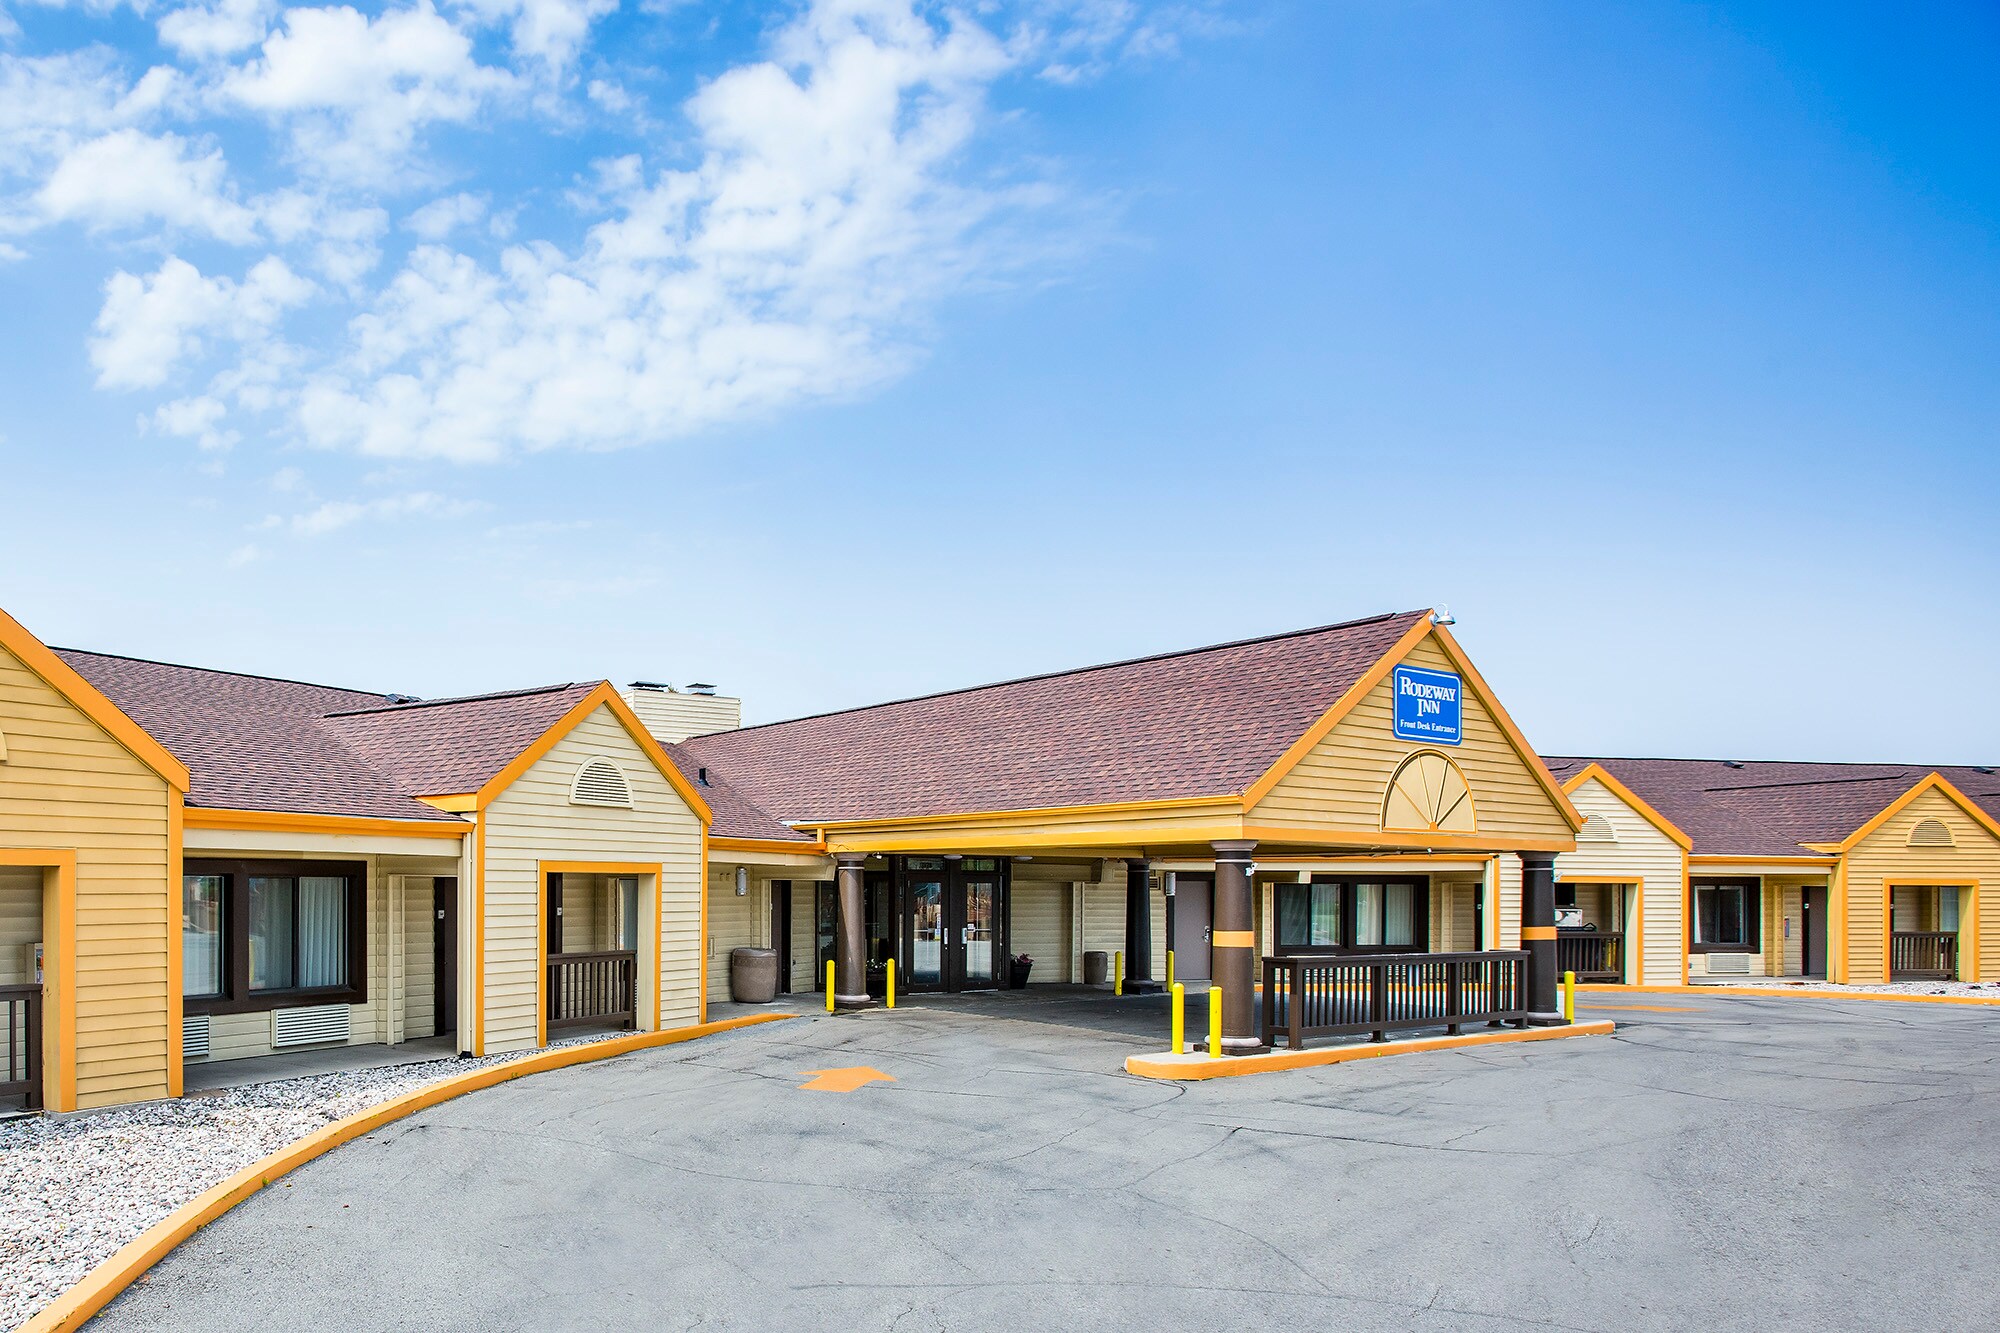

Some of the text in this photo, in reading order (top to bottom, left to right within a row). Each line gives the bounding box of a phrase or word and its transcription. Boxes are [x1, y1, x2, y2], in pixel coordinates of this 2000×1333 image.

[1400, 676, 1456, 702] RODEWAY
[1417, 698, 1440, 717] INN
[1400, 719, 1456, 733] Front Desk Entrance
